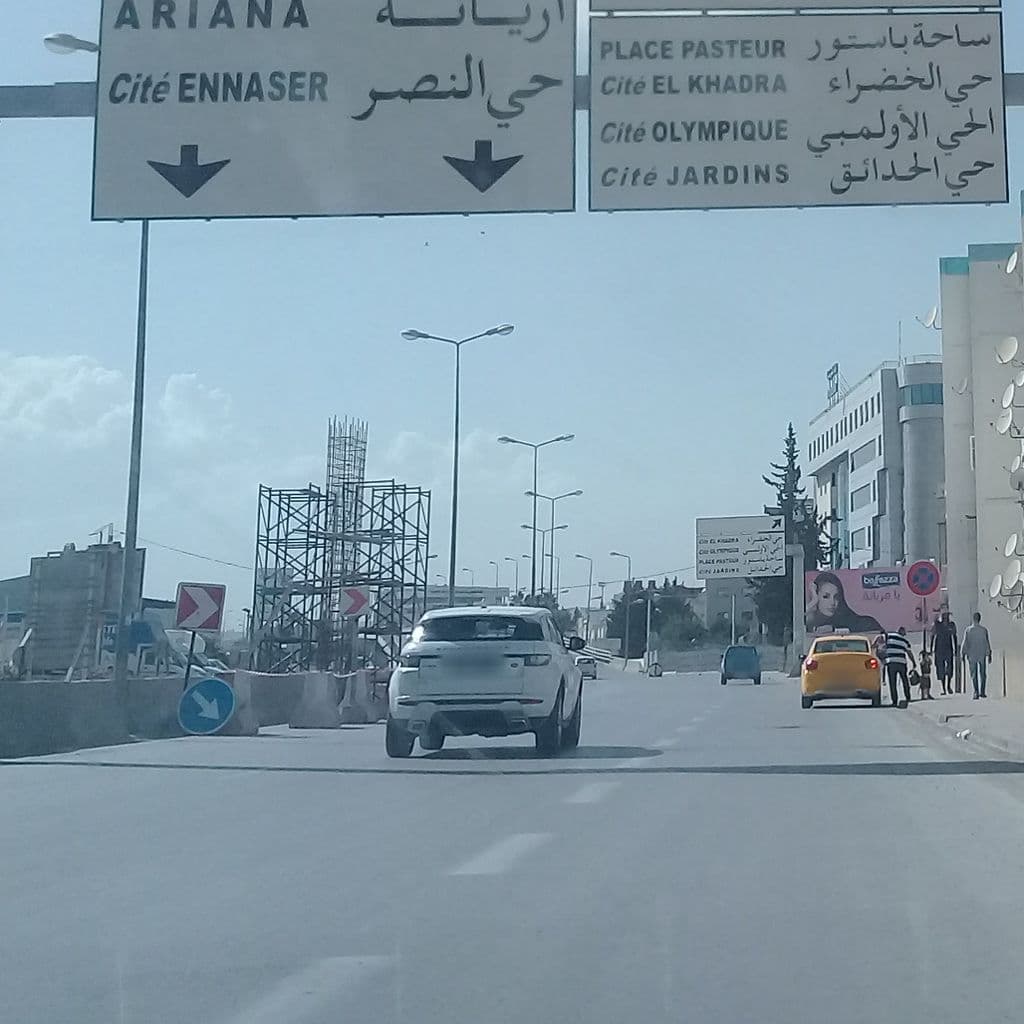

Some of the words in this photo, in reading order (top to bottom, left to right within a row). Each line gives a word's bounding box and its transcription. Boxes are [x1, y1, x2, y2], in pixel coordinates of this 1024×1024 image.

[600, 40, 674, 61] PLACE
[682, 39, 786, 59] PASTEUR
[807, 26, 909, 61] باستور
[912, 22, 991, 48] ساحة
[108, 72, 170, 104] Cité
[178, 71, 329, 103] ENNASER
[351, 53, 486, 121] النصر
[600, 76, 646, 96] Cité
[653, 75, 680, 95] EL
[688, 74, 787, 94] KHADRA
[828, 61, 941, 104] الخضراء
[944, 74, 992, 108] حي
[487, 74, 563, 128] حي
[600, 121, 646, 144] Cité
[652, 119, 788, 144] OLYMPIQUE
[937, 106, 995, 156] الحي
[601, 166, 657, 188] Cité
[667, 164, 790, 186] JARDINS
[830, 151, 940, 195] الحدائق
[945, 159, 995, 197] حي
